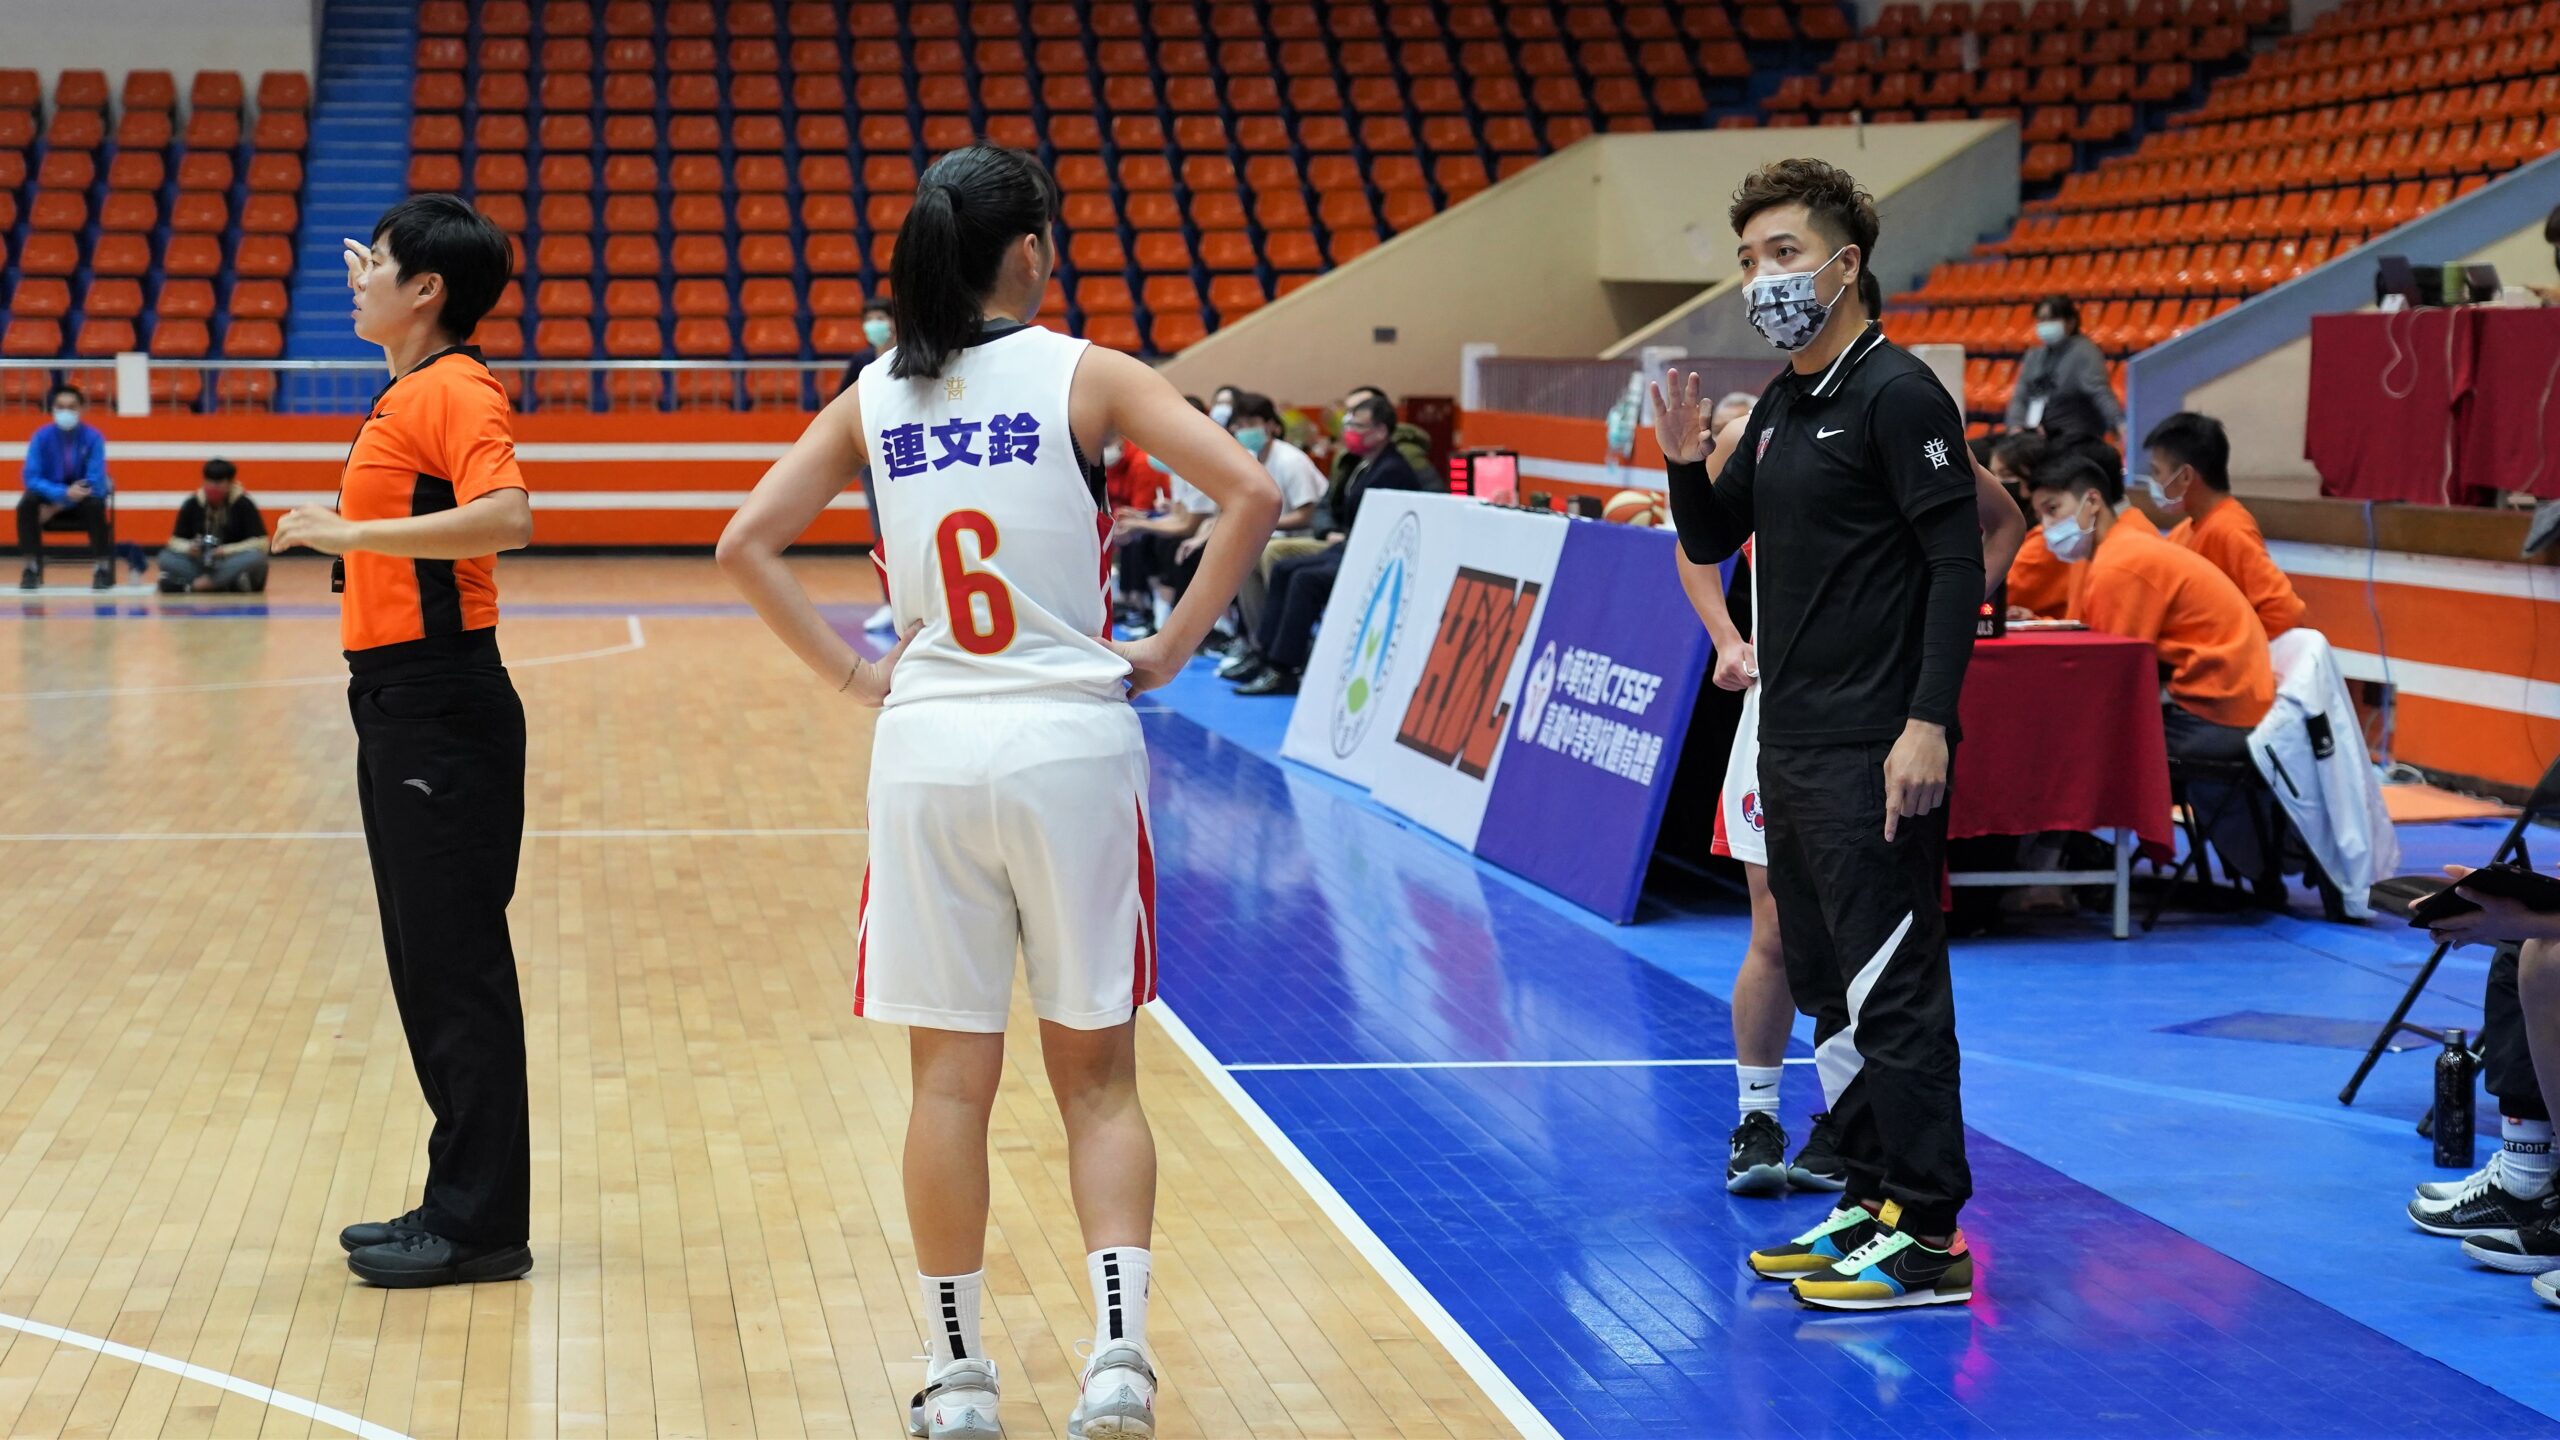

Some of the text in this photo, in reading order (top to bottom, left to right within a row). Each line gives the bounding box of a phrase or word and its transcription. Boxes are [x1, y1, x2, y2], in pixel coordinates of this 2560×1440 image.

[880, 412, 1041, 482] 連文鈴
[935, 508, 1018, 656] 6
